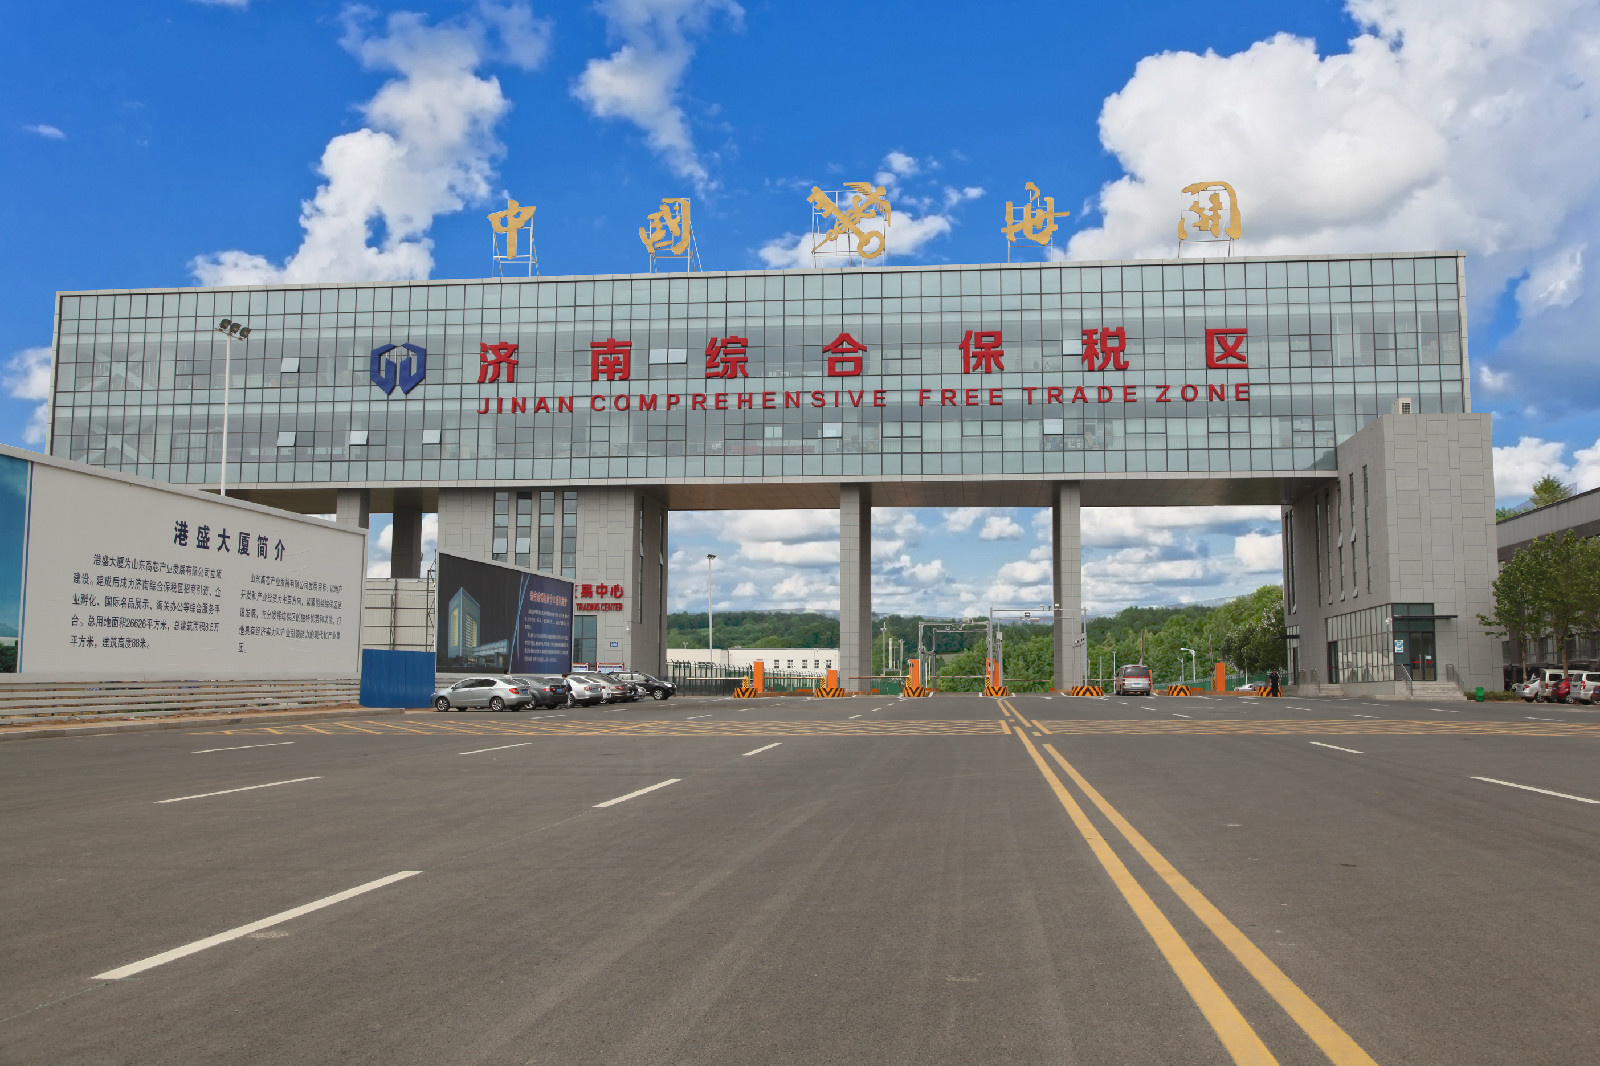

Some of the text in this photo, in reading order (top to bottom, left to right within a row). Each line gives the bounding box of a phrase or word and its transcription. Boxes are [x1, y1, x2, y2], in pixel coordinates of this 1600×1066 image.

[477, 326, 1250, 384] 济南综合保税区
[477, 382, 1251, 414] JINAN COMPREHENSIVE FREE TRADE ZONE
[173, 520, 287, 562] 港盛大厦简介
[575, 582, 624, 599] 易中心
[576, 602, 623, 611] TRADING CENTER
